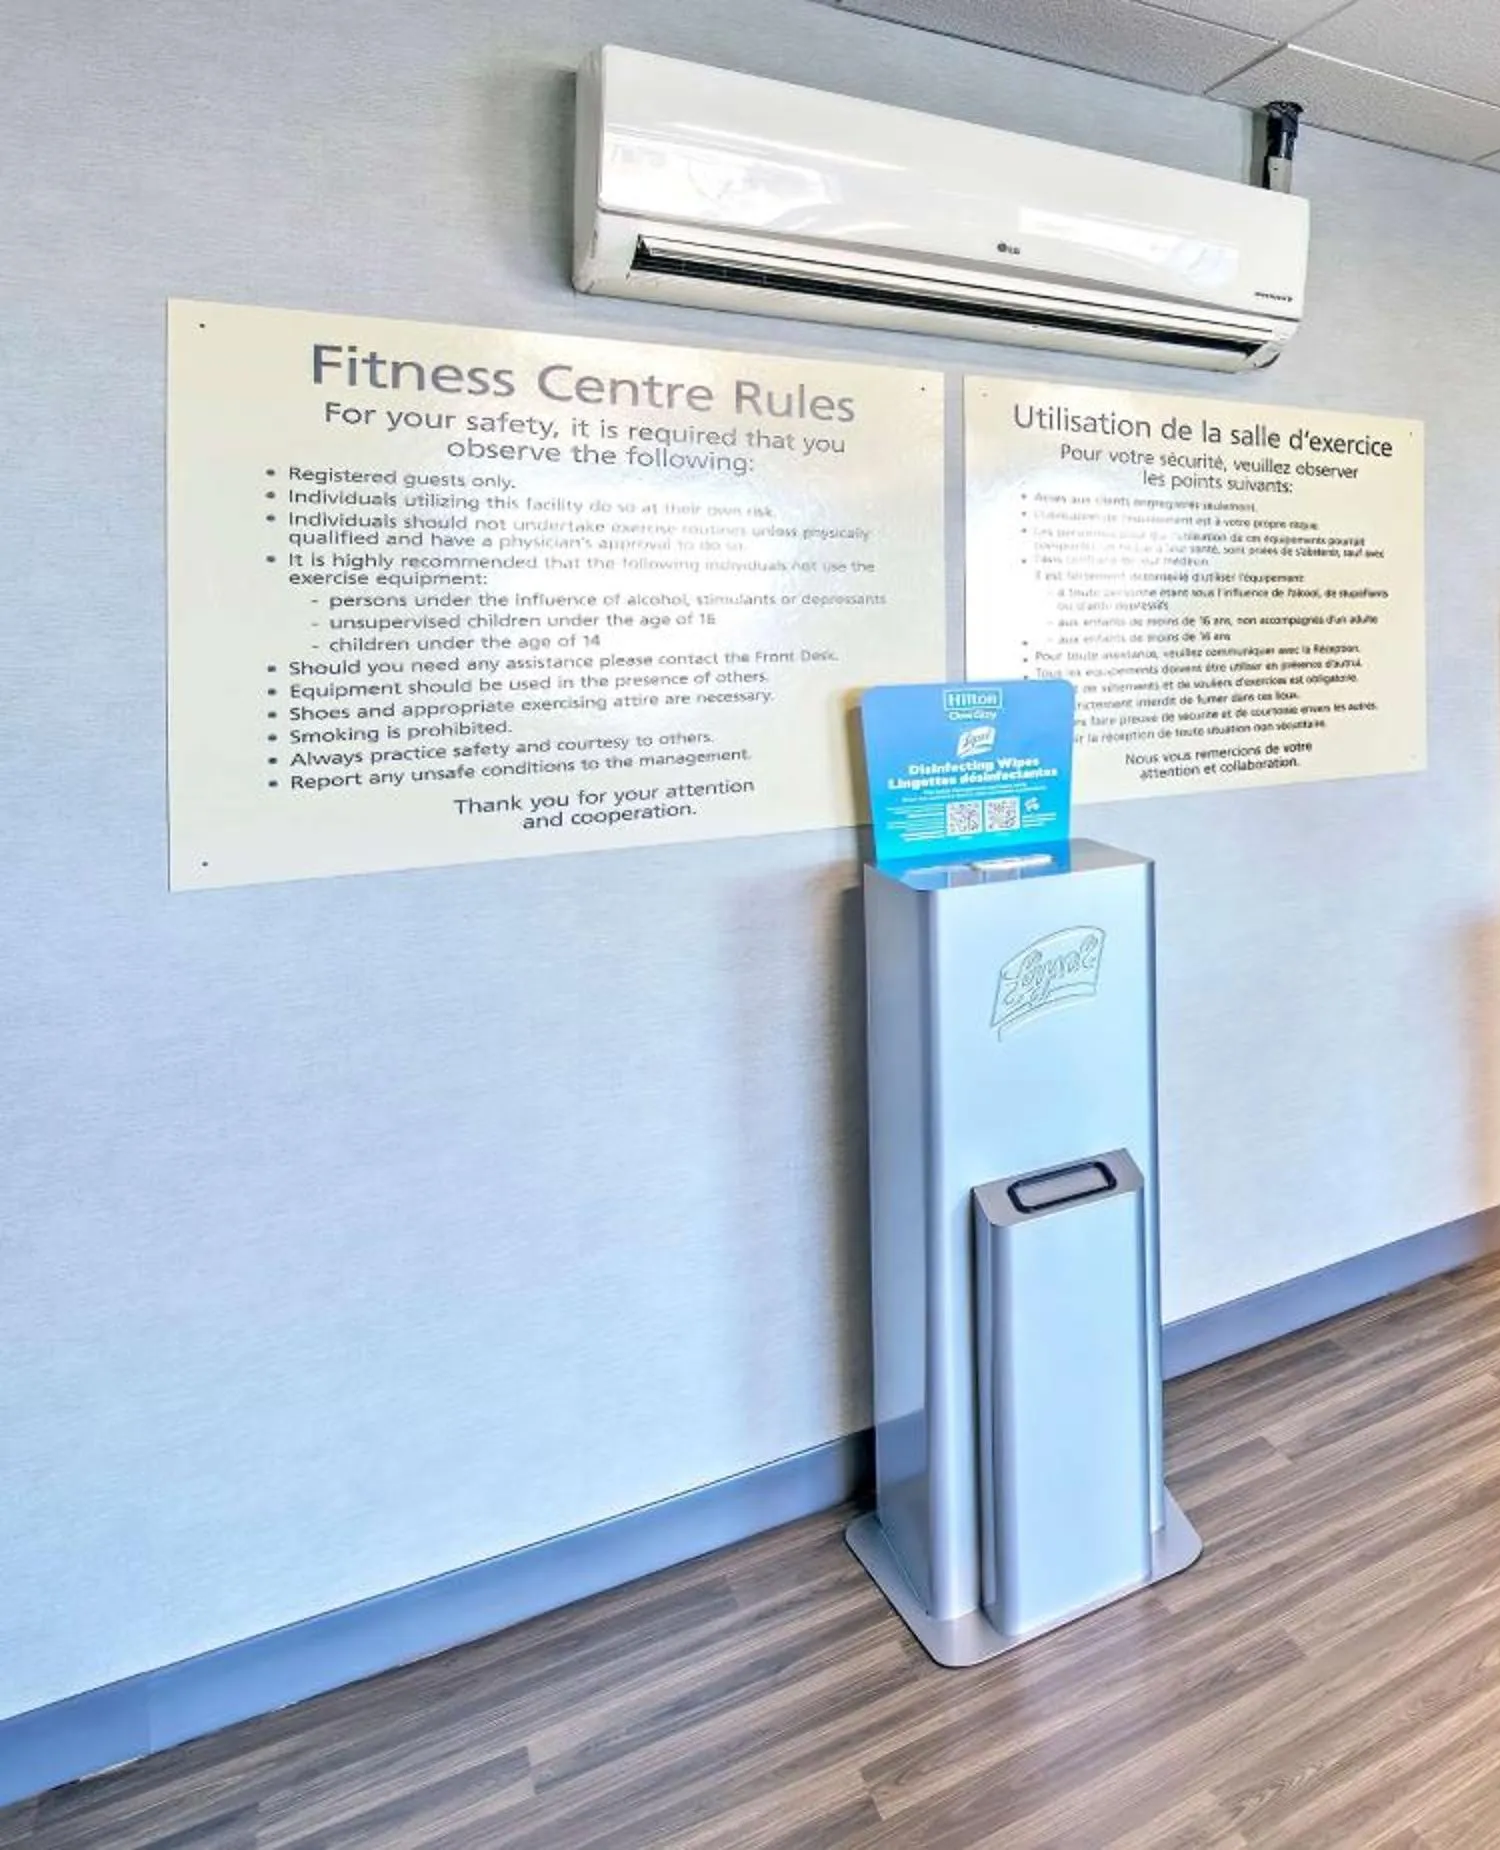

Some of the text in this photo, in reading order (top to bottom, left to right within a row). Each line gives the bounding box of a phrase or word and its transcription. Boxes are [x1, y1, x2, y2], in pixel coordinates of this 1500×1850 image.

[313, 345, 855, 421] Fitness Centre Rules
[325, 401, 845, 456] For your safety, it is required that you
[1013, 405, 1392, 456] Utilisation de la salle d'exercice
[446, 438, 754, 476] observe the following:
[1060, 445, 1358, 479] Pour votre sécurité, veuillez observer
[288, 467, 516, 491] Registered guests only.
[1143, 469, 1293, 494] les points suivants:
[289, 489, 518, 513] Individuals utilizing this
[289, 512, 506, 531] Individuals should not
[288, 531, 475, 549] qualified and have
[289, 552, 537, 572] It is highly recommended
[288, 570, 487, 589] exercise equipment:
[329, 593, 508, 611] persons under the
[329, 613, 598, 633] unsupervised children under
[329, 634, 600, 652] children under the age of 14
[288, 655, 653, 677] Should you need any assistance please
[290, 672, 768, 702] Equipment should be used in the presence of others.
[289, 697, 607, 721] Shoes and appropriate exercising
[948, 694, 997, 706] Hilton
[289, 721, 512, 744] Smoking is prohibited.
[289, 733, 714, 767] Always practice safety and courtesy to others.
[1125, 739, 1312, 765] Nous vous remercions de votre
[291, 750, 750, 791] Report any unsafe conditions to the management.
[908, 757, 1040, 775] Disinfecting Wipes
[1139, 754, 1299, 780] attention et collaboration.
[888, 776, 956, 791] Lingettes
[959, 767, 1058, 783] désinfectantes
[453, 779, 754, 815] Thank you for your attention
[522, 802, 696, 829] and cooperation.
